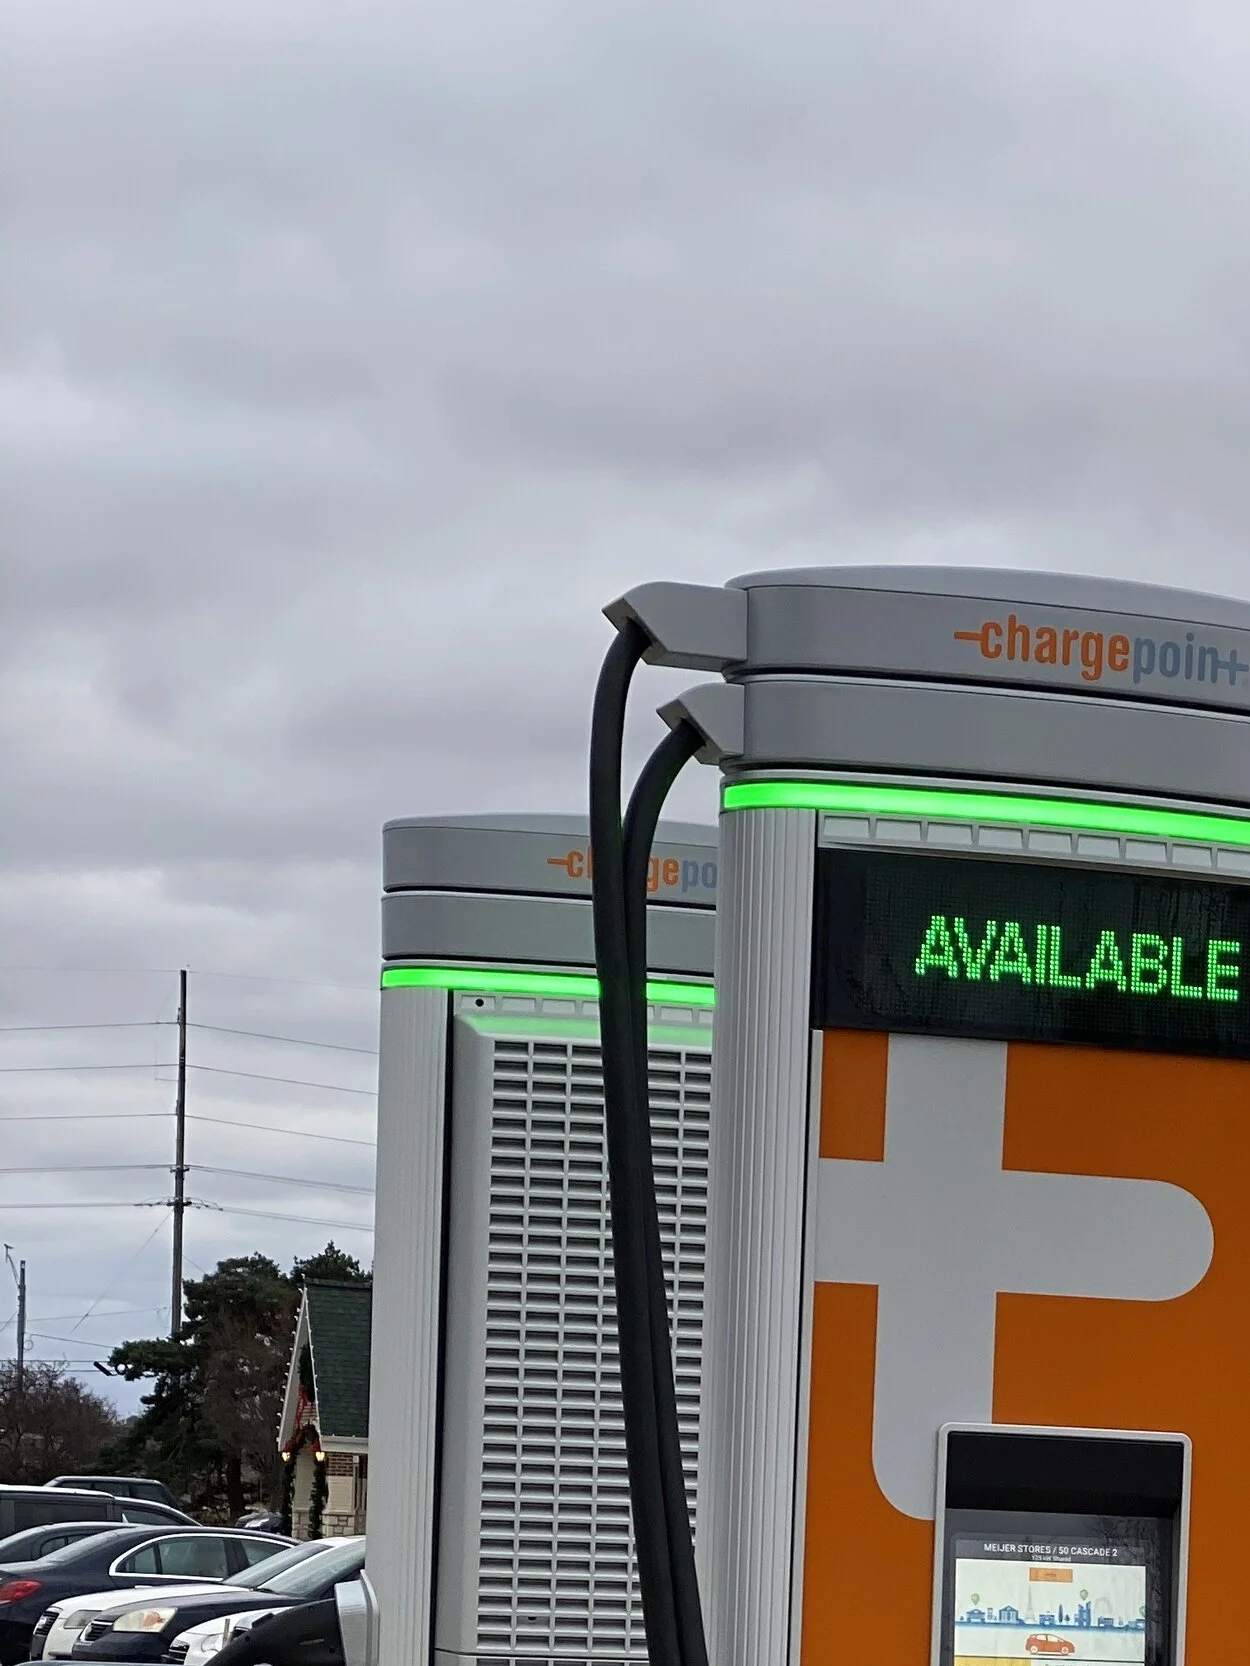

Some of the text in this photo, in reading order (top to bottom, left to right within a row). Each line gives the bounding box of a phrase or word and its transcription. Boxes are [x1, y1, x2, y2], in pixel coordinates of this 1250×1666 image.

[914, 915, 1240, 1001] AVAILABLE
[983, 1543, 1016, 1553] MEIJER
[1017, 1544, 1051, 1554] STORES
[1058, 1546, 1069, 1555] 50
[1070, 1547, 1110, 1557] CASCADE
[1112, 1548, 1118, 1557] 2
